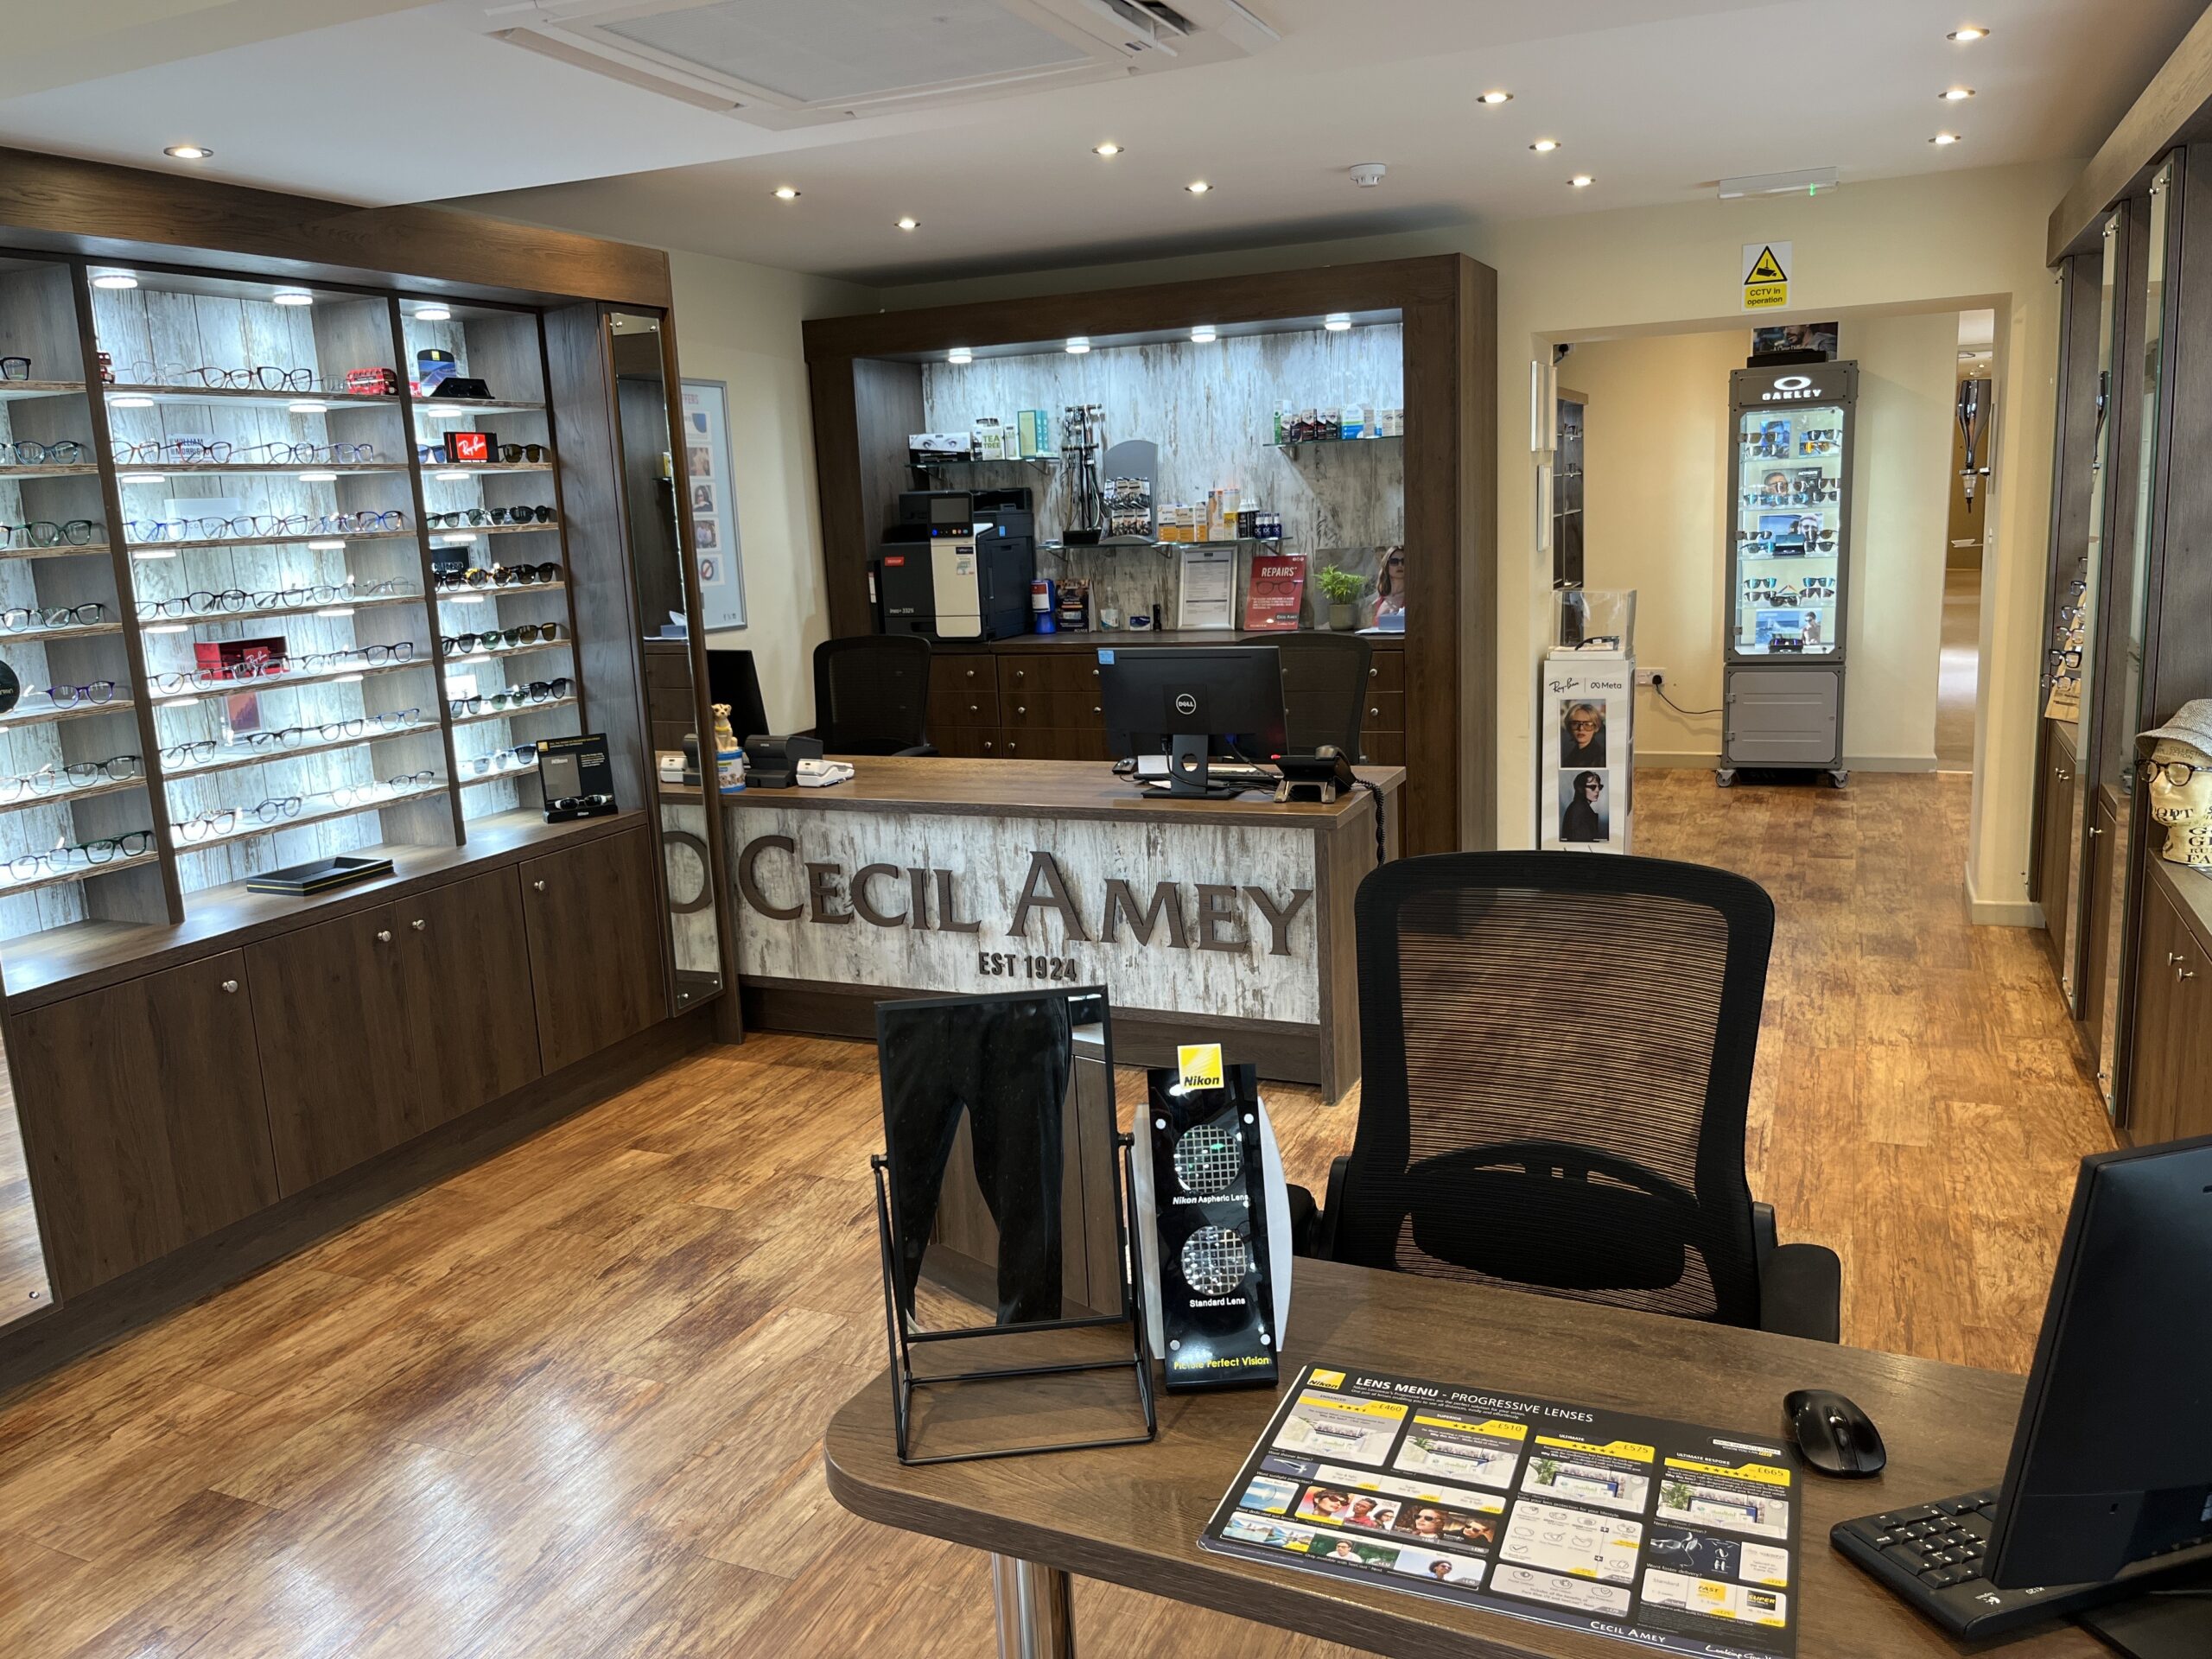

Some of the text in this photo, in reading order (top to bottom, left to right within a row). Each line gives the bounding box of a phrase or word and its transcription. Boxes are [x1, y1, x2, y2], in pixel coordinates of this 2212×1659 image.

[1750, 288, 1771, 296] CCTV
[1747, 296, 1783, 306] operation
[1762, 389, 1821, 401] OAKLEY
[738, 835, 1314, 957] CECIL AMEY
[978, 951, 1077, 982] EST 1924
[1183, 1074, 1220, 1087] Nikon
[1172, 1192, 1249, 1205] Nikon Aspheric Lens
[1189, 1297, 1246, 1307] Standard Lens
[1205, 1357, 1239, 1369] Perfect
[1241, 1356, 1269, 1366] Vision
[1307, 1379, 1339, 1389] Nikon
[1354, 1376, 1392, 1389] LENS
[1393, 1382, 1439, 1397] MENU
[1450, 1391, 1541, 1413] PROGRESSIVE
[1543, 1407, 1594, 1422] LENSES
[1377, 1403, 1402, 1412] £460
[1497, 1422, 1522, 1432] £510
[1558, 1433, 1585, 1441] ULTIMATE
[1623, 1444, 1649, 1453] £575
[1675, 1452, 1730, 1465] ULTIMATE BESPOKE
[1757, 1466, 1783, 1477] £665
[1677, 1568, 1702, 1578] delivery?
[1697, 1585, 1719, 1593] FAST
[2025, 1586, 2045, 1595] K120
[1746, 1593, 1776, 1605] SUPER
[1588, 1619, 1625, 1635] CECIL
[1626, 1627, 1667, 1643] AMEY
[1705, 1644, 1743, 1659] Looking
